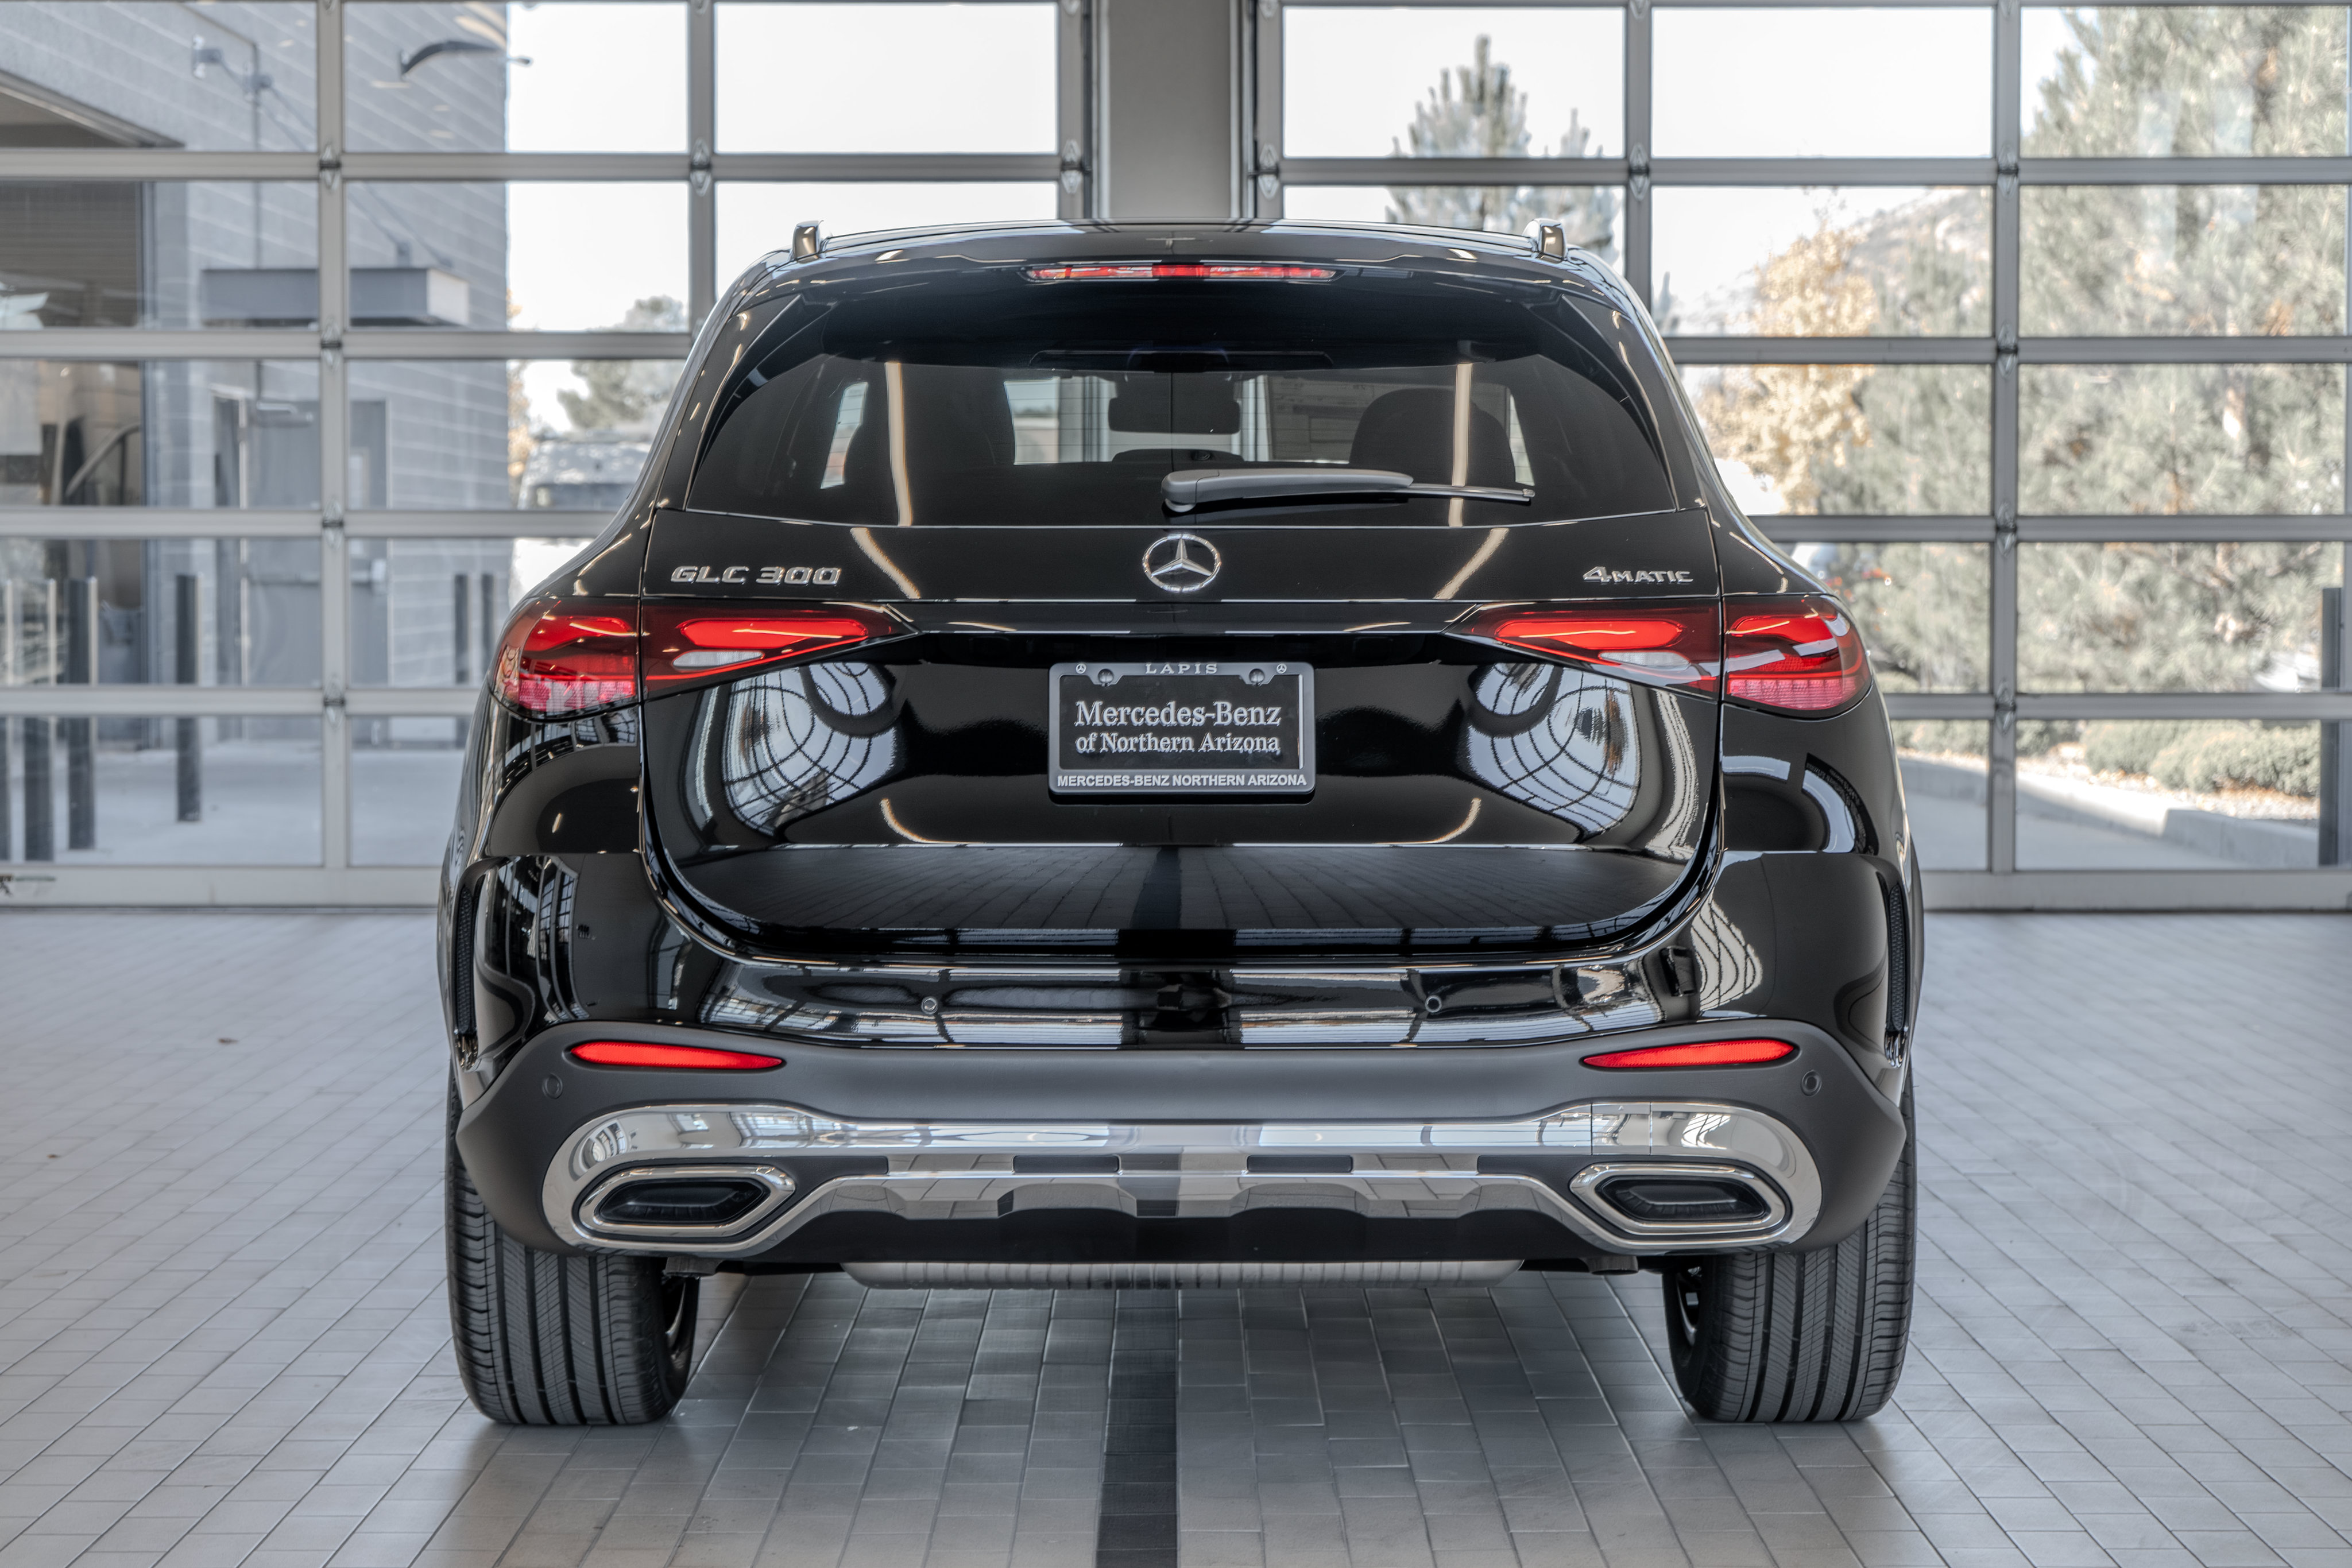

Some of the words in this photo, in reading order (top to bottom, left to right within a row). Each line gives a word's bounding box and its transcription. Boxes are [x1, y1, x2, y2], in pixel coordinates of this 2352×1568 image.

[671, 566, 749, 584] GLC
[756, 566, 842, 586] 300
[1146, 663, 1218, 675] LAPIS
[1074, 700, 1282, 727] Mercedes-Benz
[1075, 732, 1097, 753] of
[1099, 733, 1194, 753] Northern
[1198, 733, 1281, 754] Arizona
[1057, 775, 1170, 787] MERCEDES-BENZ
[1172, 775, 1245, 787] NORTHERN
[1247, 774, 1307, 786] ARIZONA
